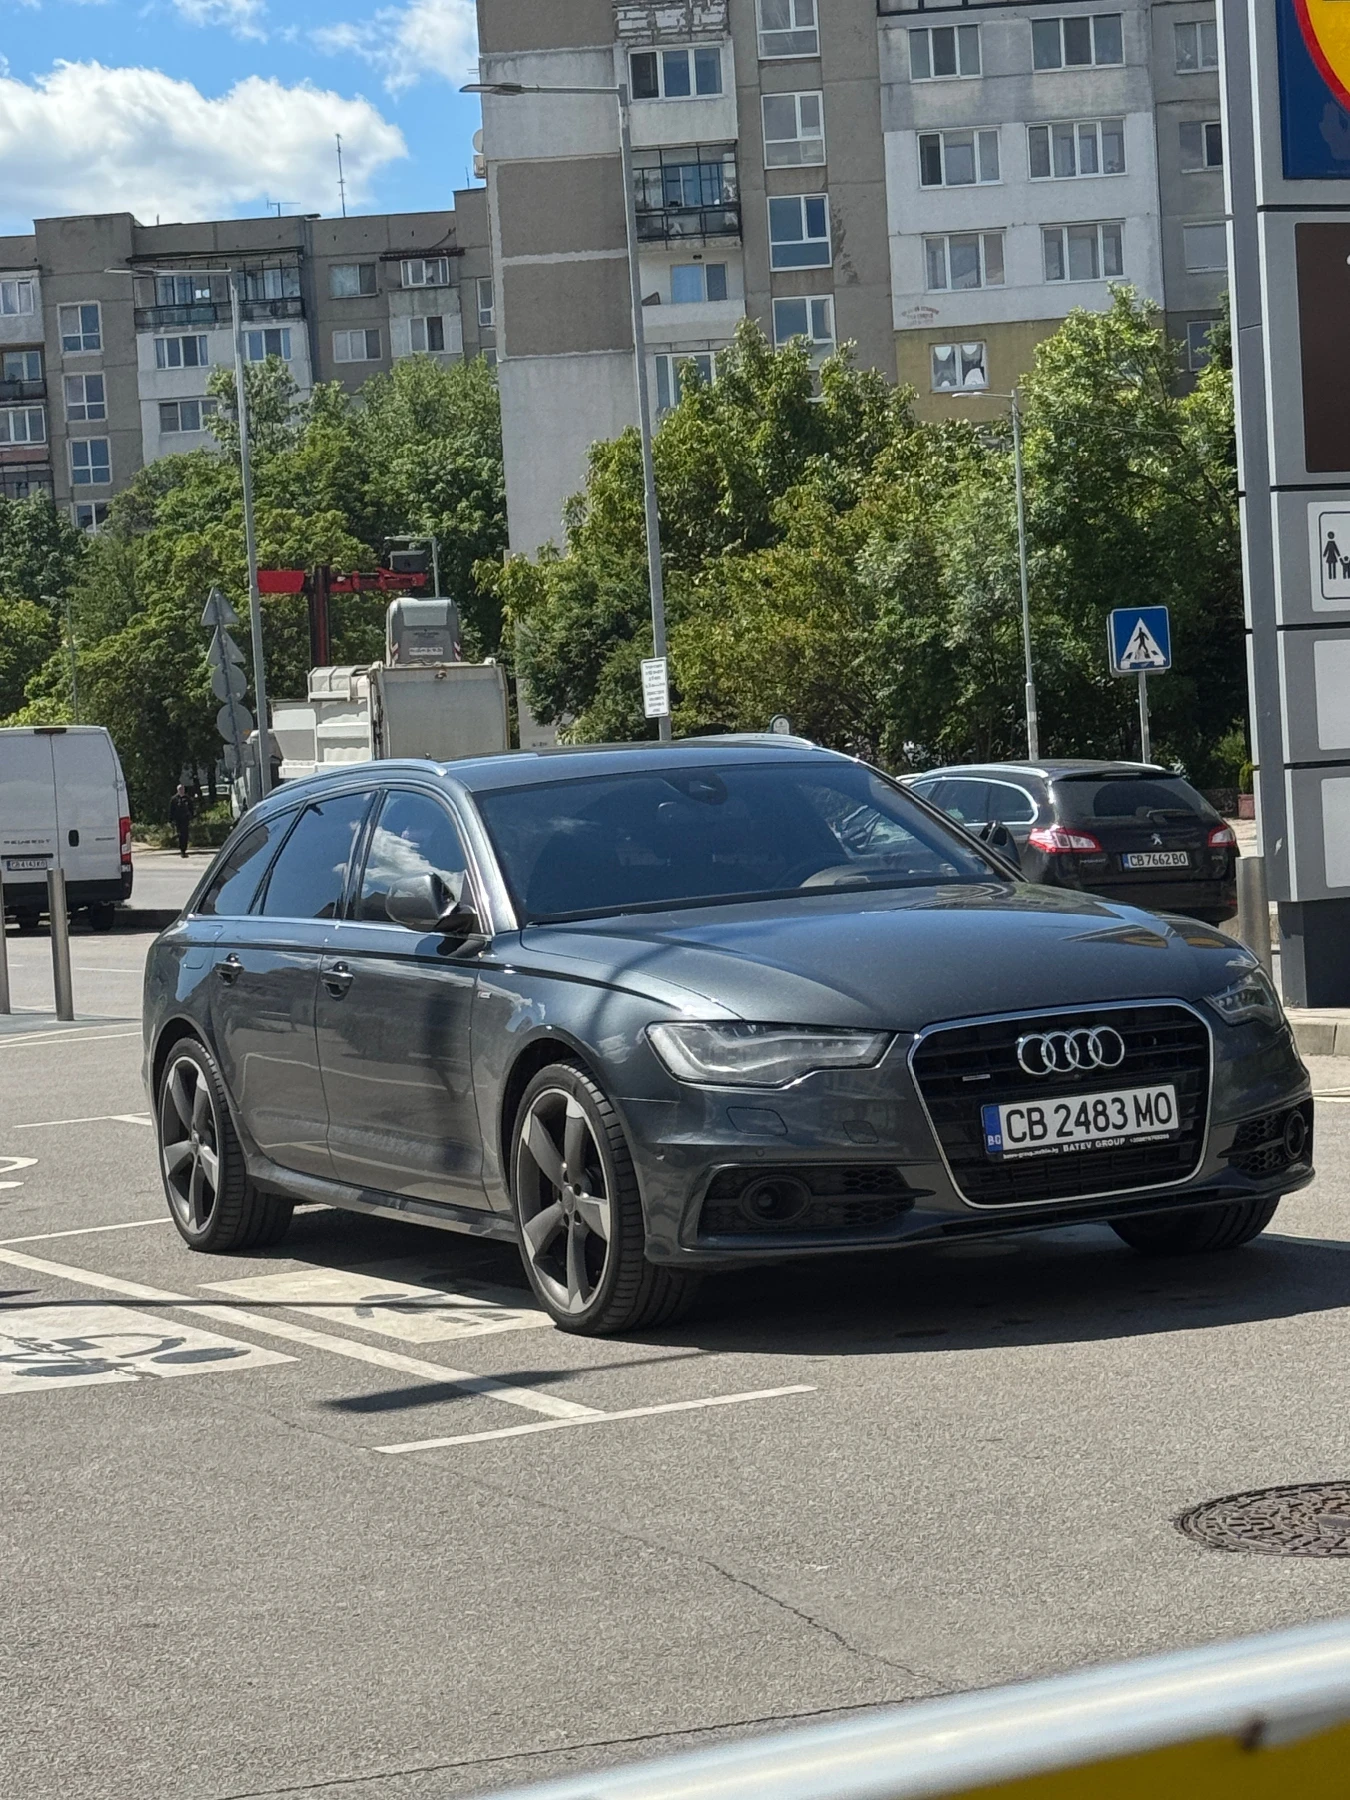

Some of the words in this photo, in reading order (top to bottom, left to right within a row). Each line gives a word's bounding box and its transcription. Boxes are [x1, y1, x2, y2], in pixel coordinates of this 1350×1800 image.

[1005, 1107, 1048, 1144] CB
[1053, 1097, 1128, 1138] 2483
[1132, 1091, 1173, 1129] MO
[987, 1134, 1001, 1146] BG
[1062, 1140, 1092, 1153] BATEV
[1095, 1137, 1126, 1149] GROUP
